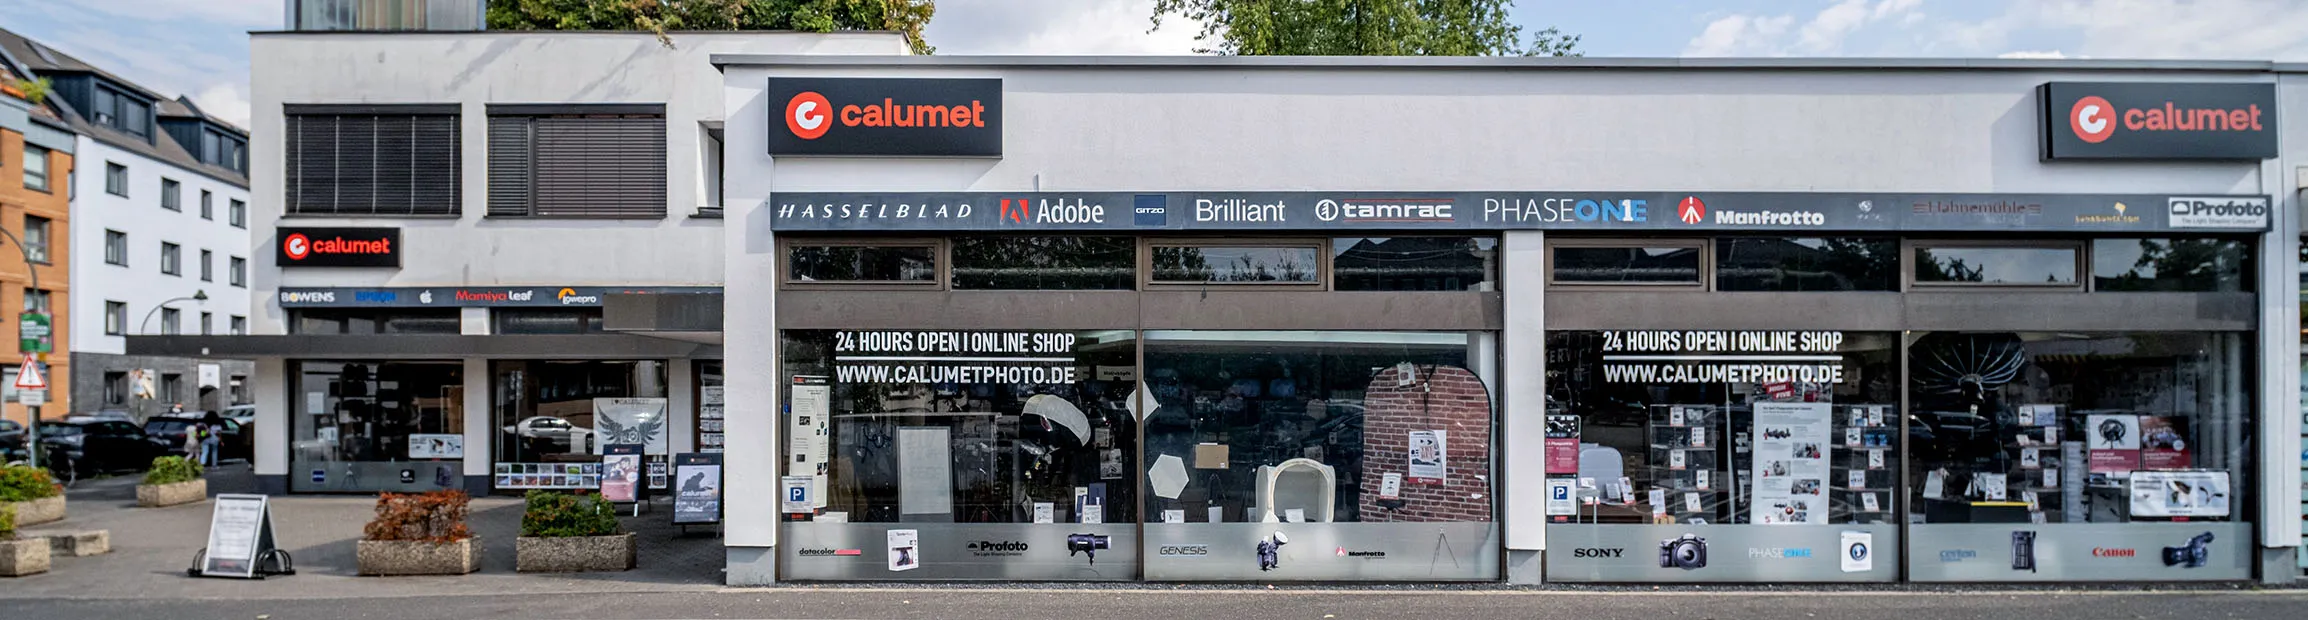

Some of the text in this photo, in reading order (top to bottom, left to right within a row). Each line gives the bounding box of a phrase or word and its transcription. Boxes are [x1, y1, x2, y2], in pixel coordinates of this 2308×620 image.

[840, 98, 985, 128] calumet
[2124, 102, 2262, 131] calumet
[777, 203, 972, 219] HASSELBLAD
[1036, 198, 1105, 224] Adobe
[1196, 199, 1286, 222] Brilliant
[1342, 202, 1454, 218] tamrac
[2193, 200, 2266, 217] Profoto
[1715, 210, 1825, 226] Manfrotto
[312, 236, 391, 254] calumet
[281, 291, 335, 302] BOWENS
[456, 290, 534, 302] Mamiya leaf
[835, 331, 855, 352] 24
[860, 331, 913, 352] HOURS
[918, 332, 959, 352] OPEN
[972, 332, 1029, 353] ONLINE
[1033, 332, 1075, 353] SHOP
[1603, 330, 1623, 351] 24
[1627, 331, 1681, 352] HOURS
[1685, 331, 1727, 352] OPEN
[1739, 331, 1797, 352] ONLINE
[1800, 331, 1843, 352] SHOP
[835, 365, 1075, 384] WWW.CALUMETPHOTO.DE
[1603, 364, 1843, 383] WWW.CALUMETPHOTO.DE
[799, 547, 836, 555] datacolor
[980, 540, 1029, 551] Profoto
[1159, 546, 1208, 556] GENESIS
[1574, 548, 1624, 558] SONY
[2092, 547, 2136, 557] Canon
